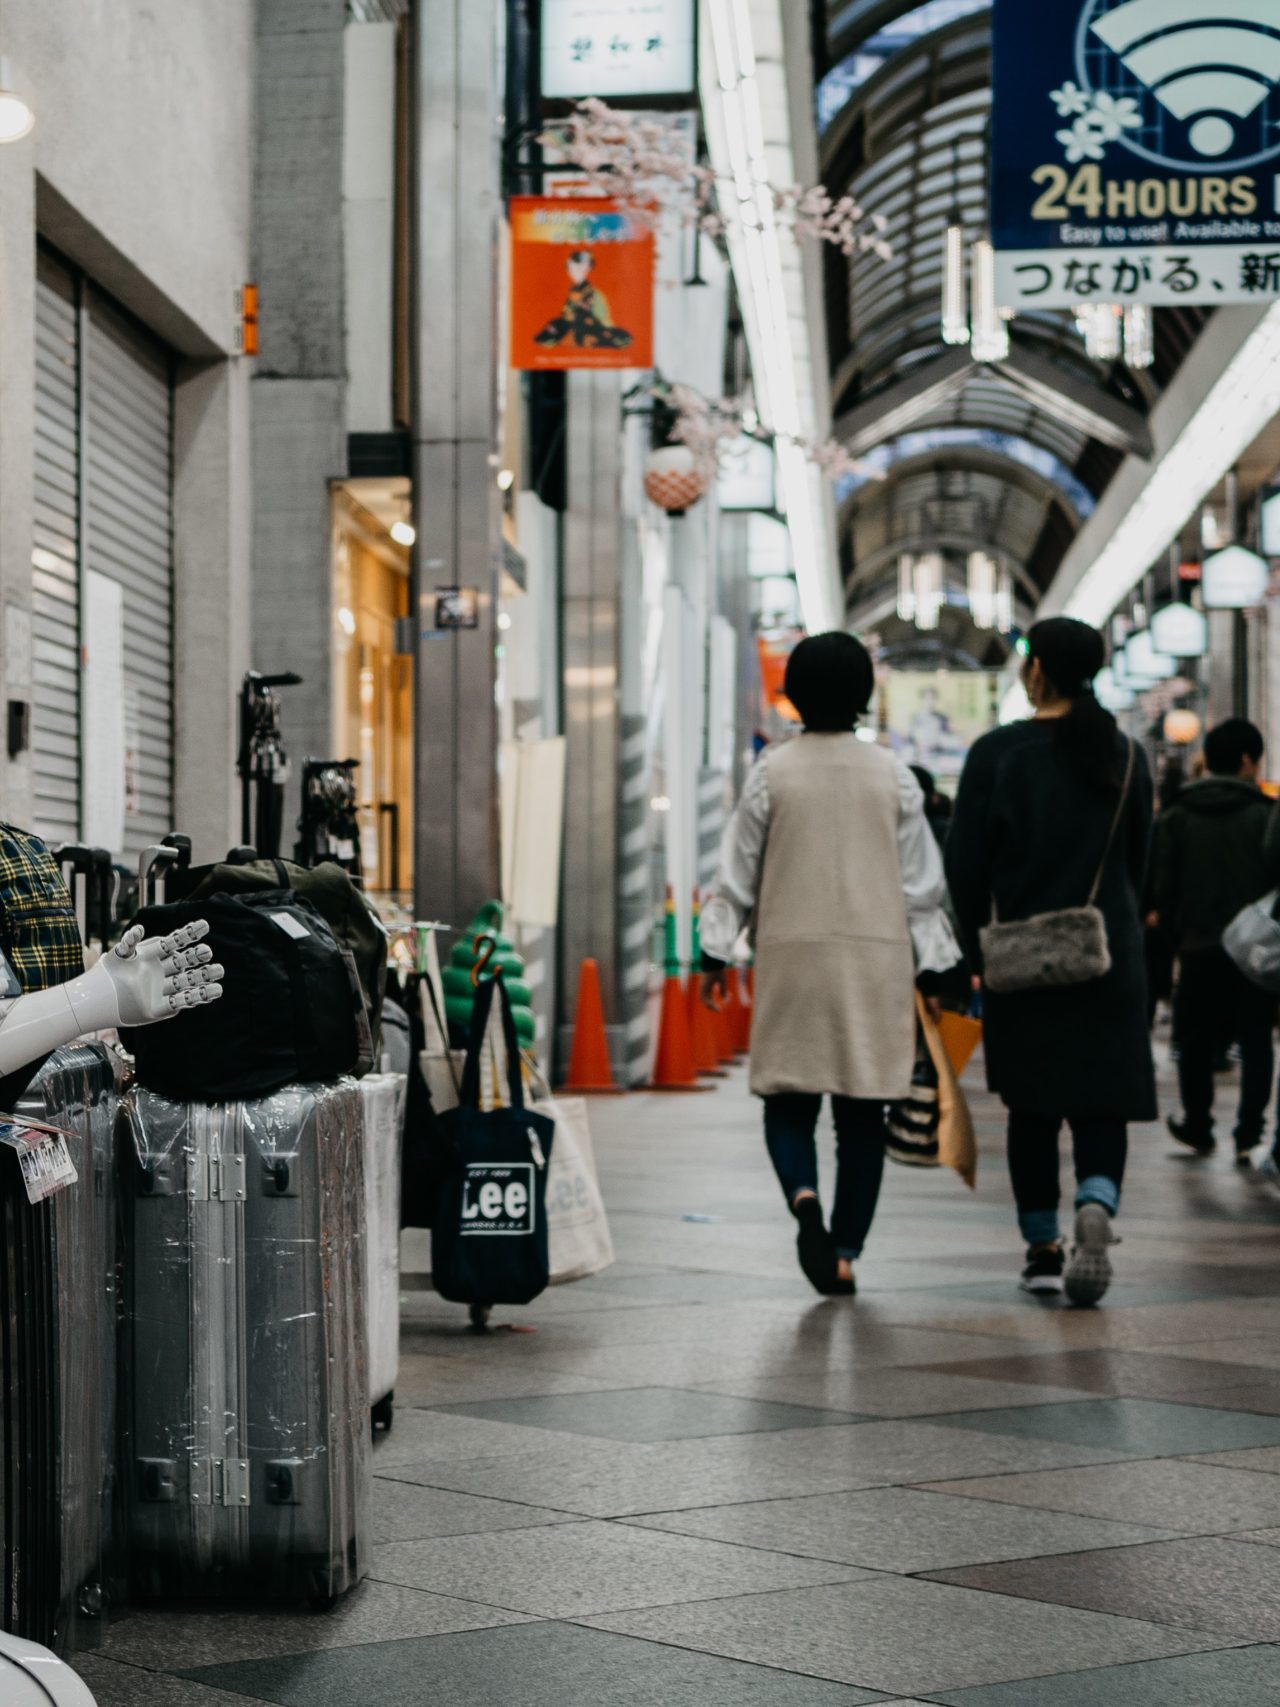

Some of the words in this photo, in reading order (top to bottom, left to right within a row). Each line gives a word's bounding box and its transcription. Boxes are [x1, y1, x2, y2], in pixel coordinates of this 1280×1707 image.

[1059, 222, 1102, 247] Easy
[1105, 224, 1126, 242] to
[1175, 217, 1261, 240] Available
[461, 1180, 528, 1219] Lee
